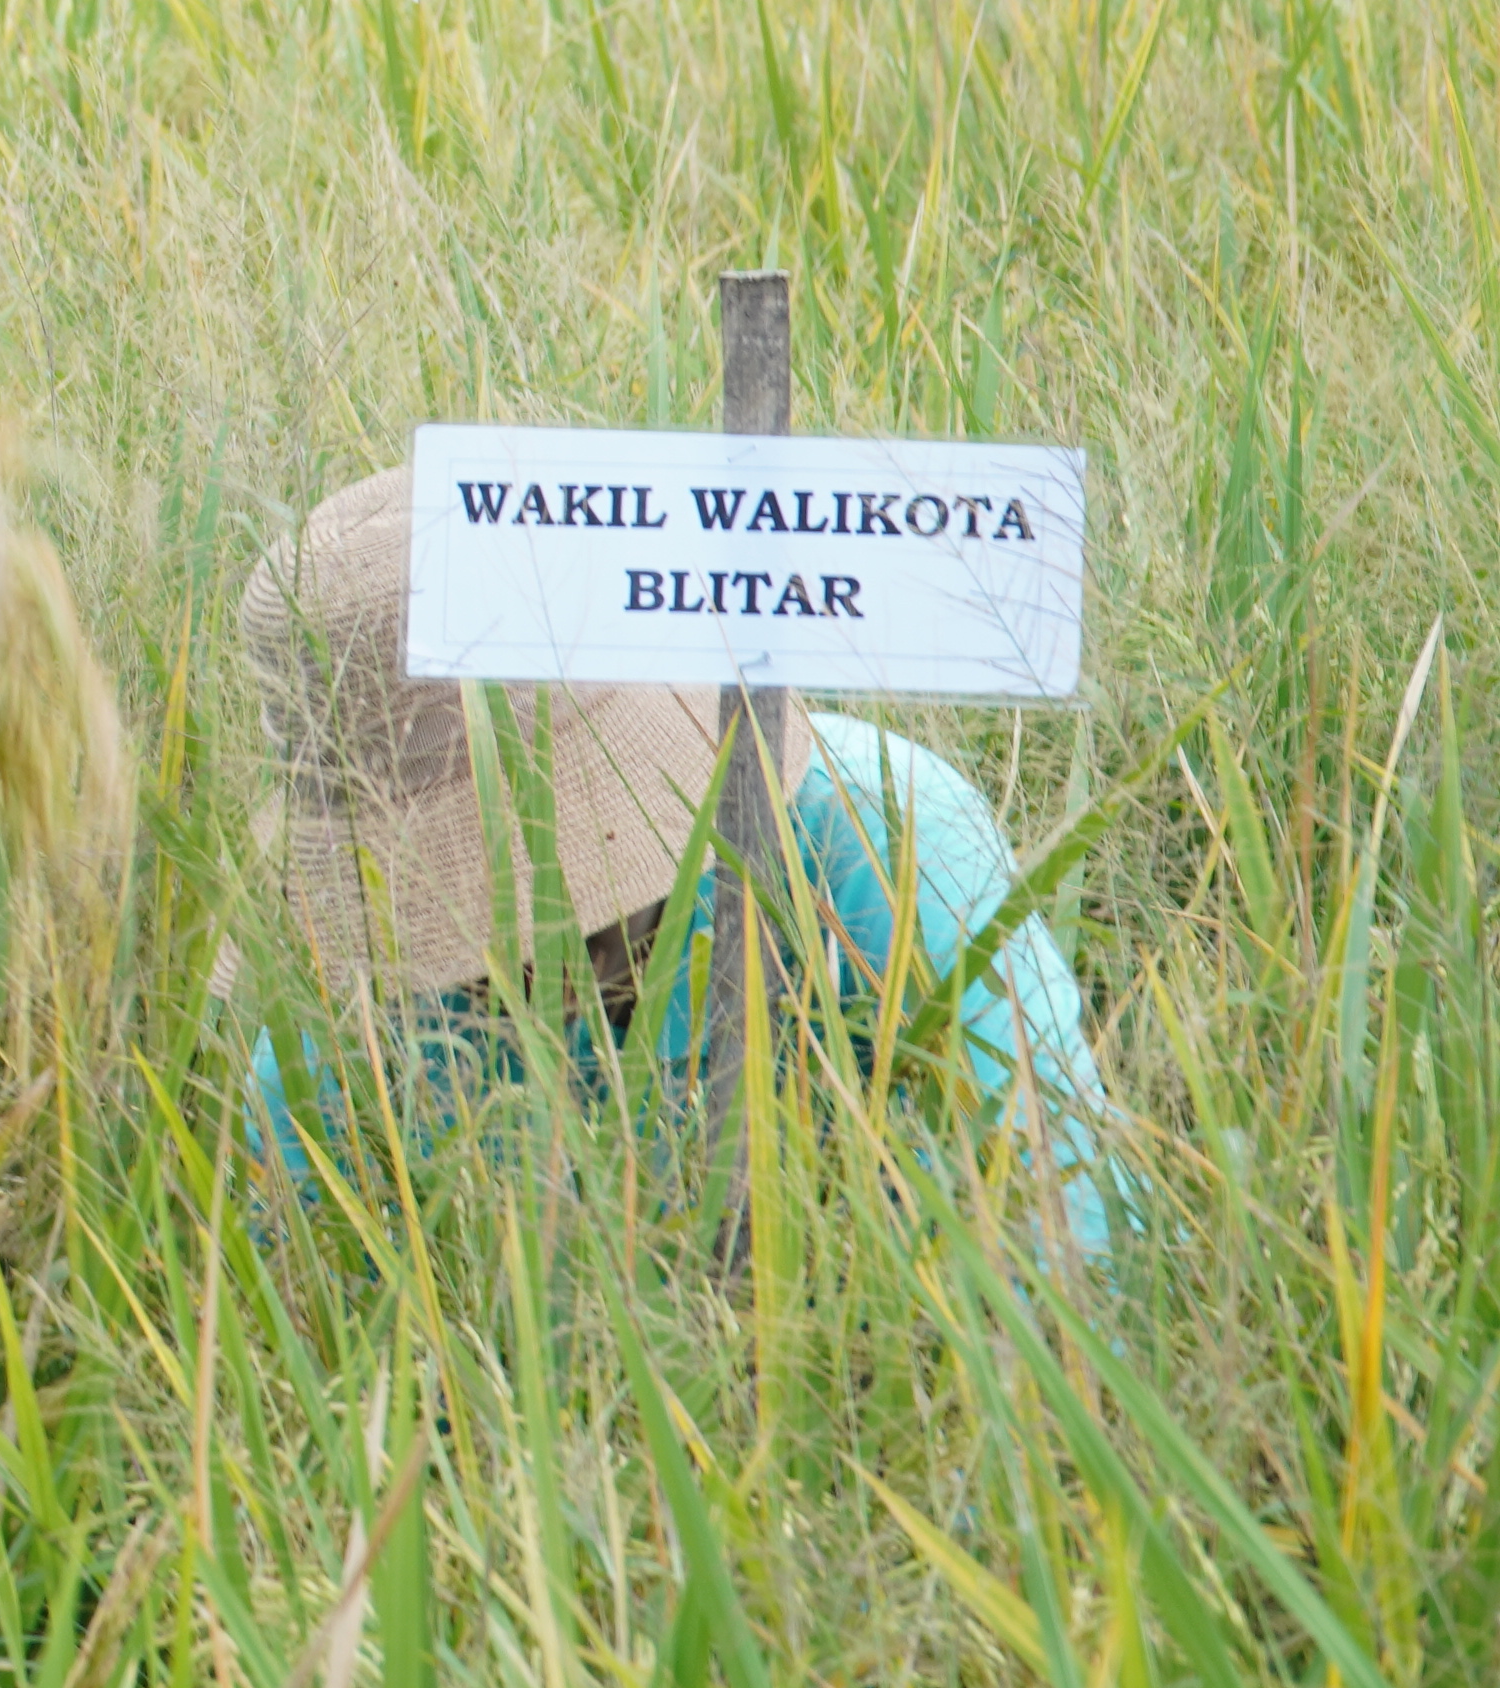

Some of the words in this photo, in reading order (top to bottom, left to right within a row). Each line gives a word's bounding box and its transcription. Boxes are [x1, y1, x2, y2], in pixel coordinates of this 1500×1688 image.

[457, 480, 668, 530] WAKIL
[689, 487, 1037, 541] WALIKOTA
[624, 569, 865, 618] BLITAR
